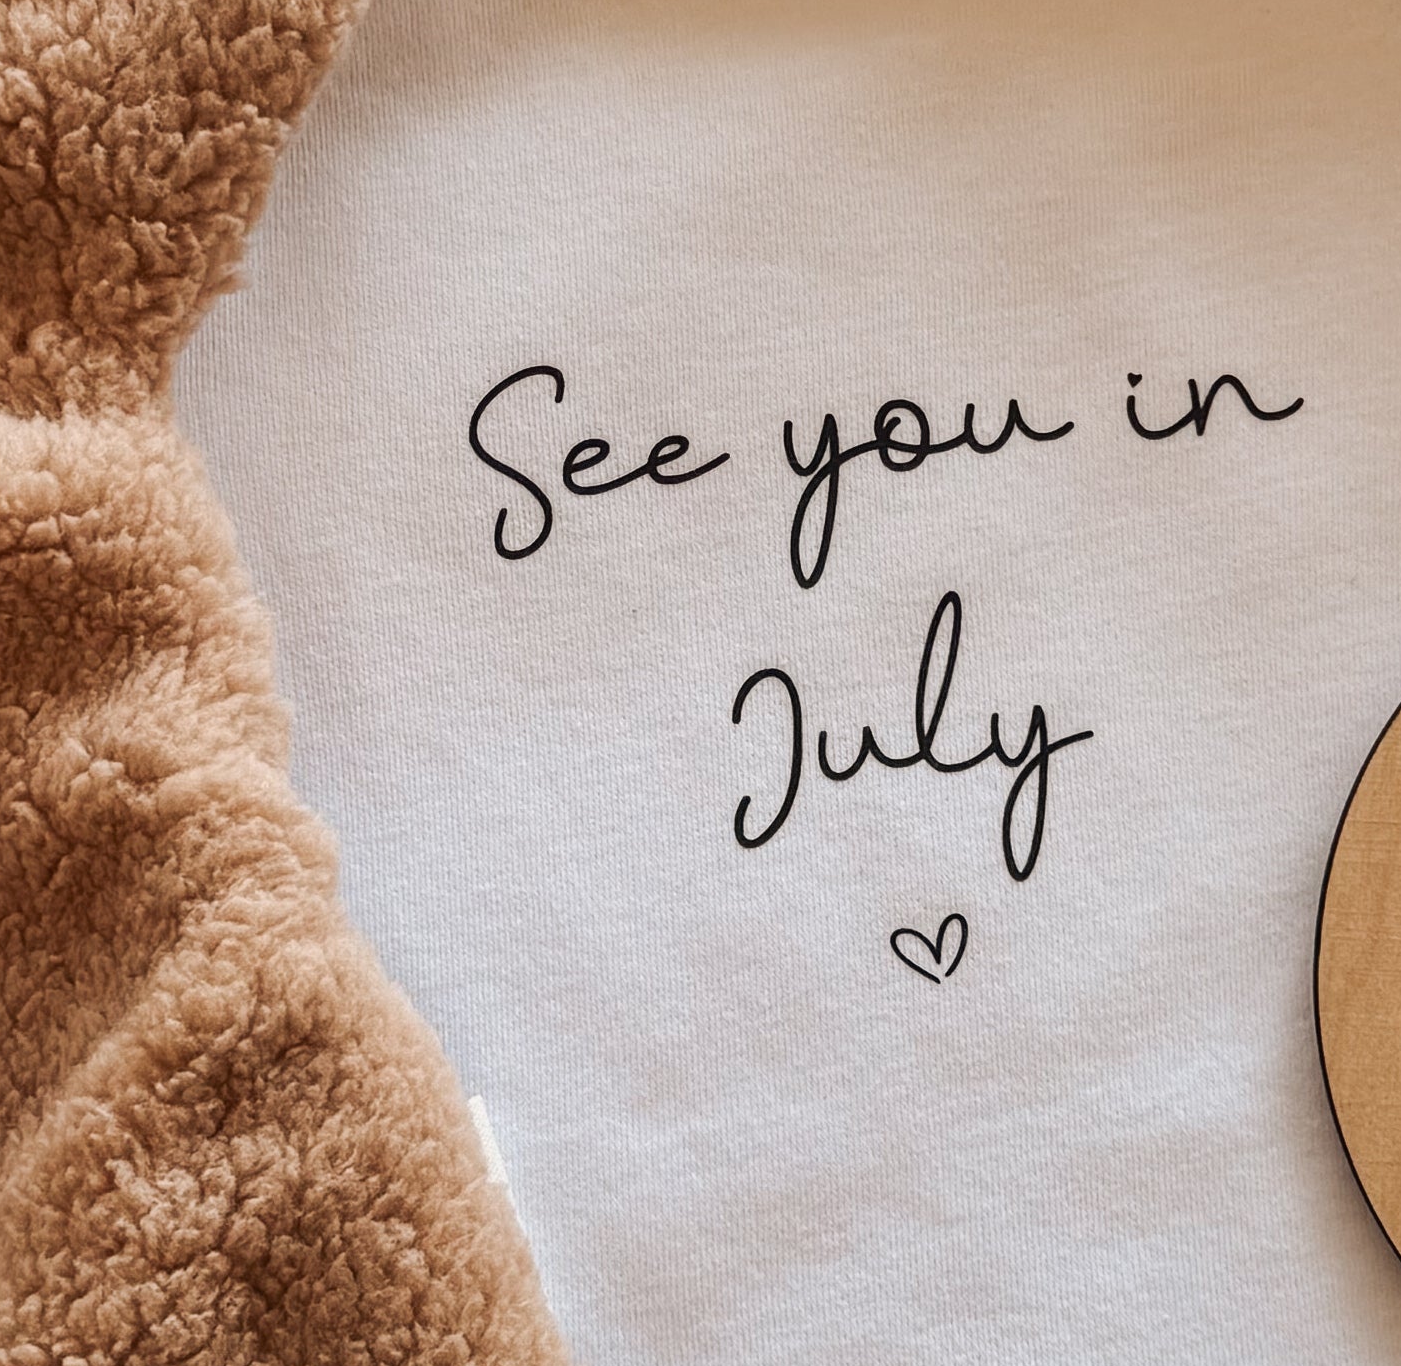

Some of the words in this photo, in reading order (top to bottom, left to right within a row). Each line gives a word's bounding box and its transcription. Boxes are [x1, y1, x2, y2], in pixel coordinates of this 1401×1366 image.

[468, 364, 731, 561] See
[782, 398, 1075, 589] you
[1126, 372, 1305, 441] in
[731, 590, 1095, 883] July
